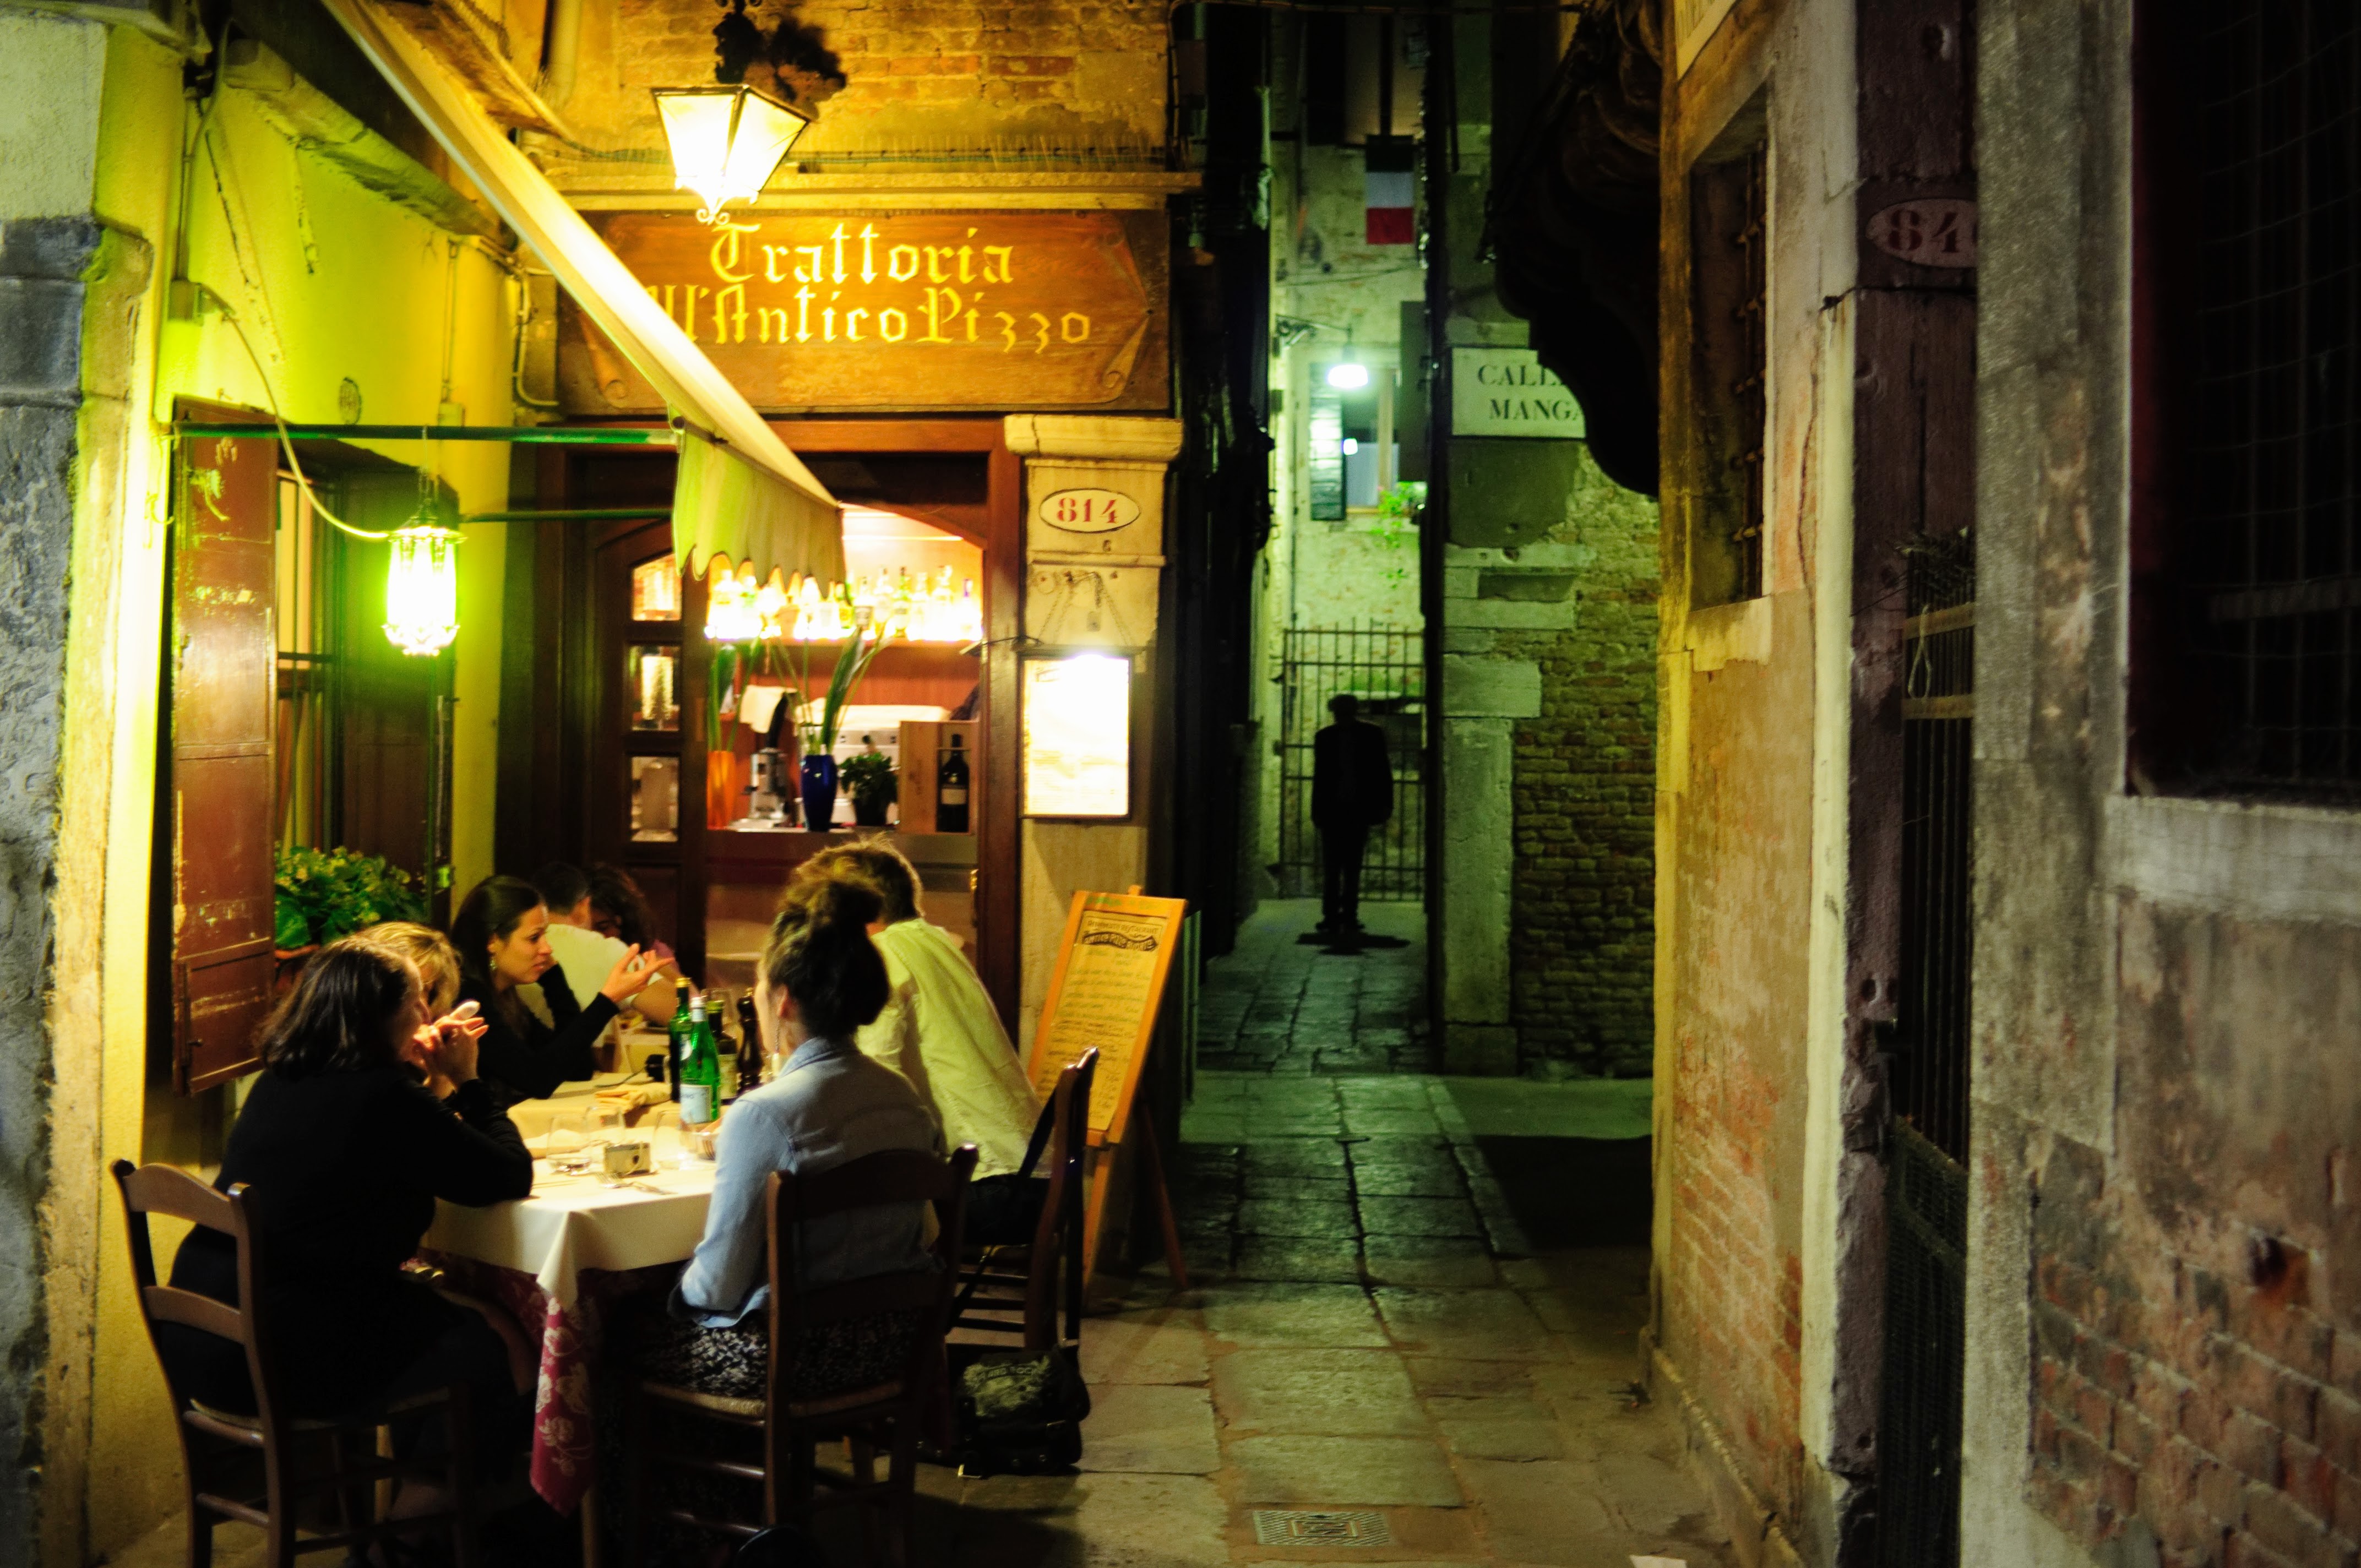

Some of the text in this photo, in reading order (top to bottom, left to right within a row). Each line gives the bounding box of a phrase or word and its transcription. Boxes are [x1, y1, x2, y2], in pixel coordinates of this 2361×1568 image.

[1888, 209, 1978, 253] 84
[710, 222, 1014, 285] Trattoria
[917, 286, 1091, 353] Pizzo
[1477, 364, 1564, 386] CALL
[1489, 398, 1581, 421] MANG
[1056, 497, 1118, 524] 814
